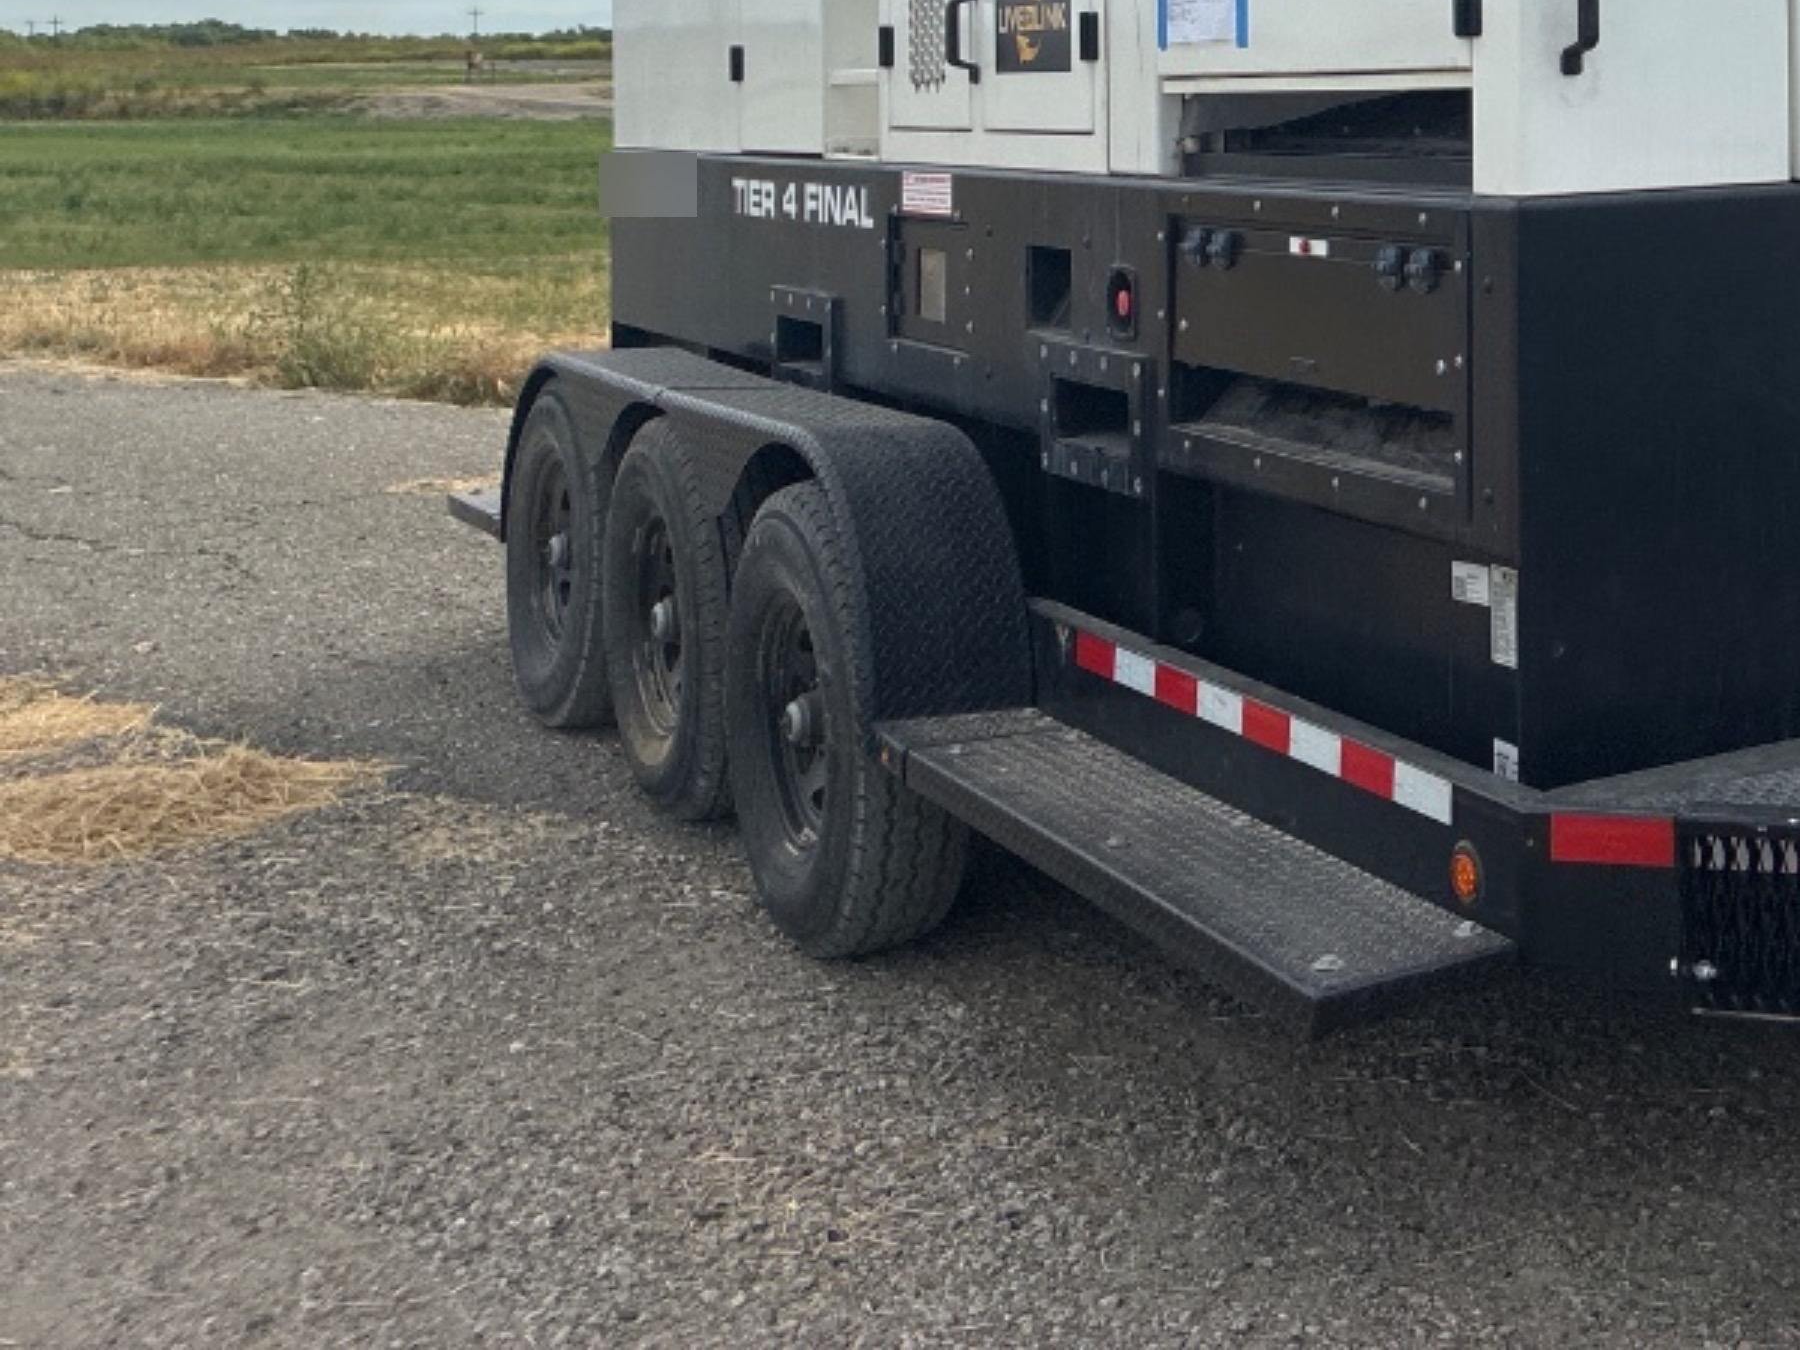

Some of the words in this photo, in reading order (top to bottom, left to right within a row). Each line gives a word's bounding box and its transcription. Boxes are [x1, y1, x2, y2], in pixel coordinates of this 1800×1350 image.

[731, 177, 775, 219] TIER
[782, 182, 797, 221] 4
[804, 183, 874, 228] FINAL
